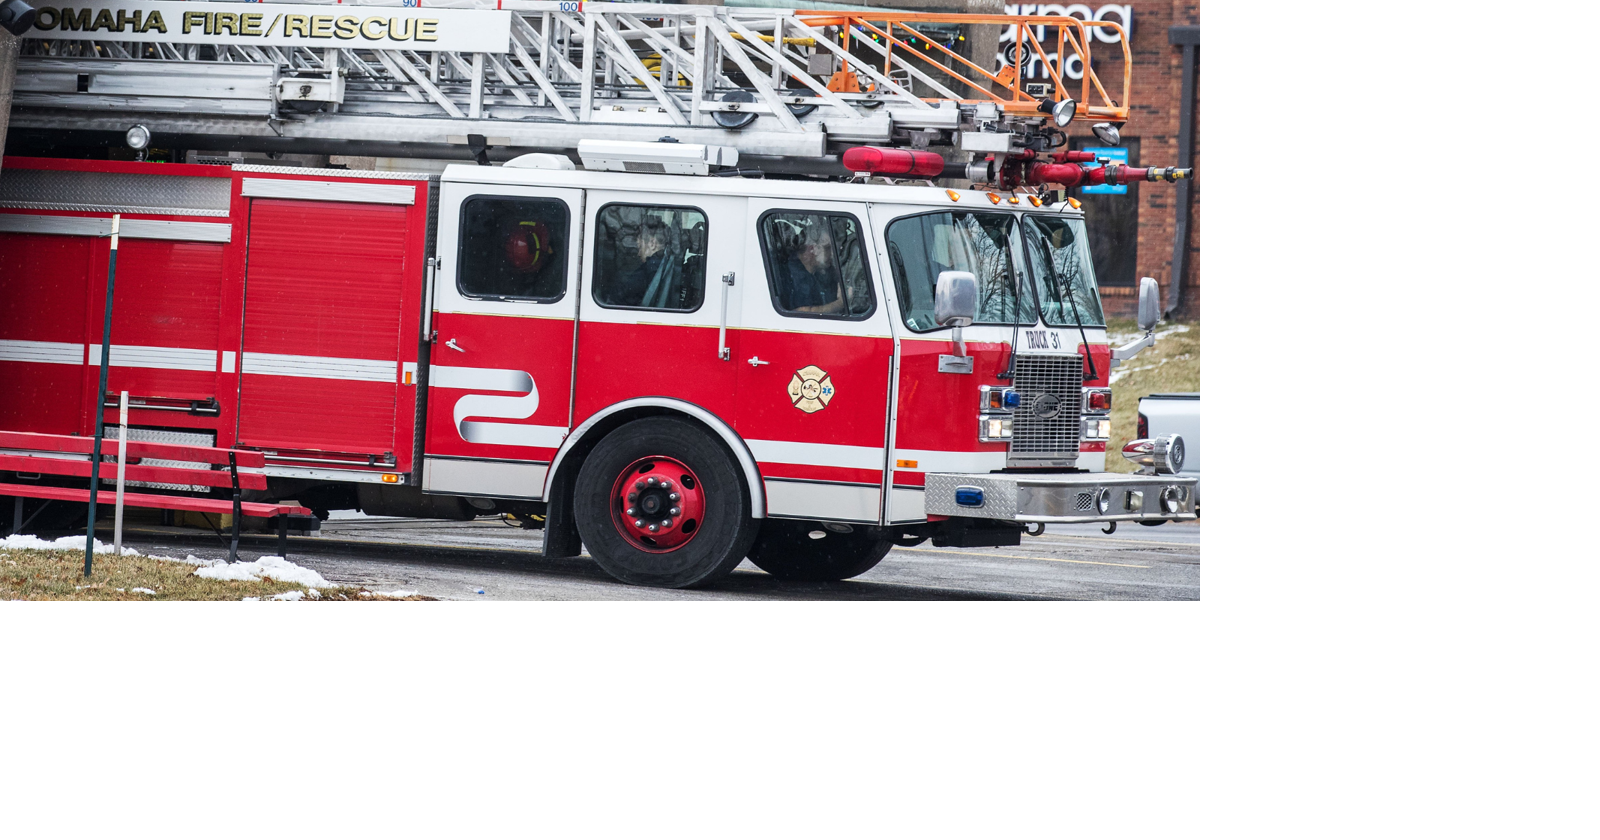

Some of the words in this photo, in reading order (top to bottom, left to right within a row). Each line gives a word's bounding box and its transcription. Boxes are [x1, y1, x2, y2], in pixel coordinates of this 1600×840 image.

[559, 2, 577, 11] 100
[33, 7, 168, 33] OMAHA
[182, 11, 440, 42] FIRE/RESCUE
[1025, 330, 1049, 349] TRUCK
[1050, 331, 1062, 349] 31
